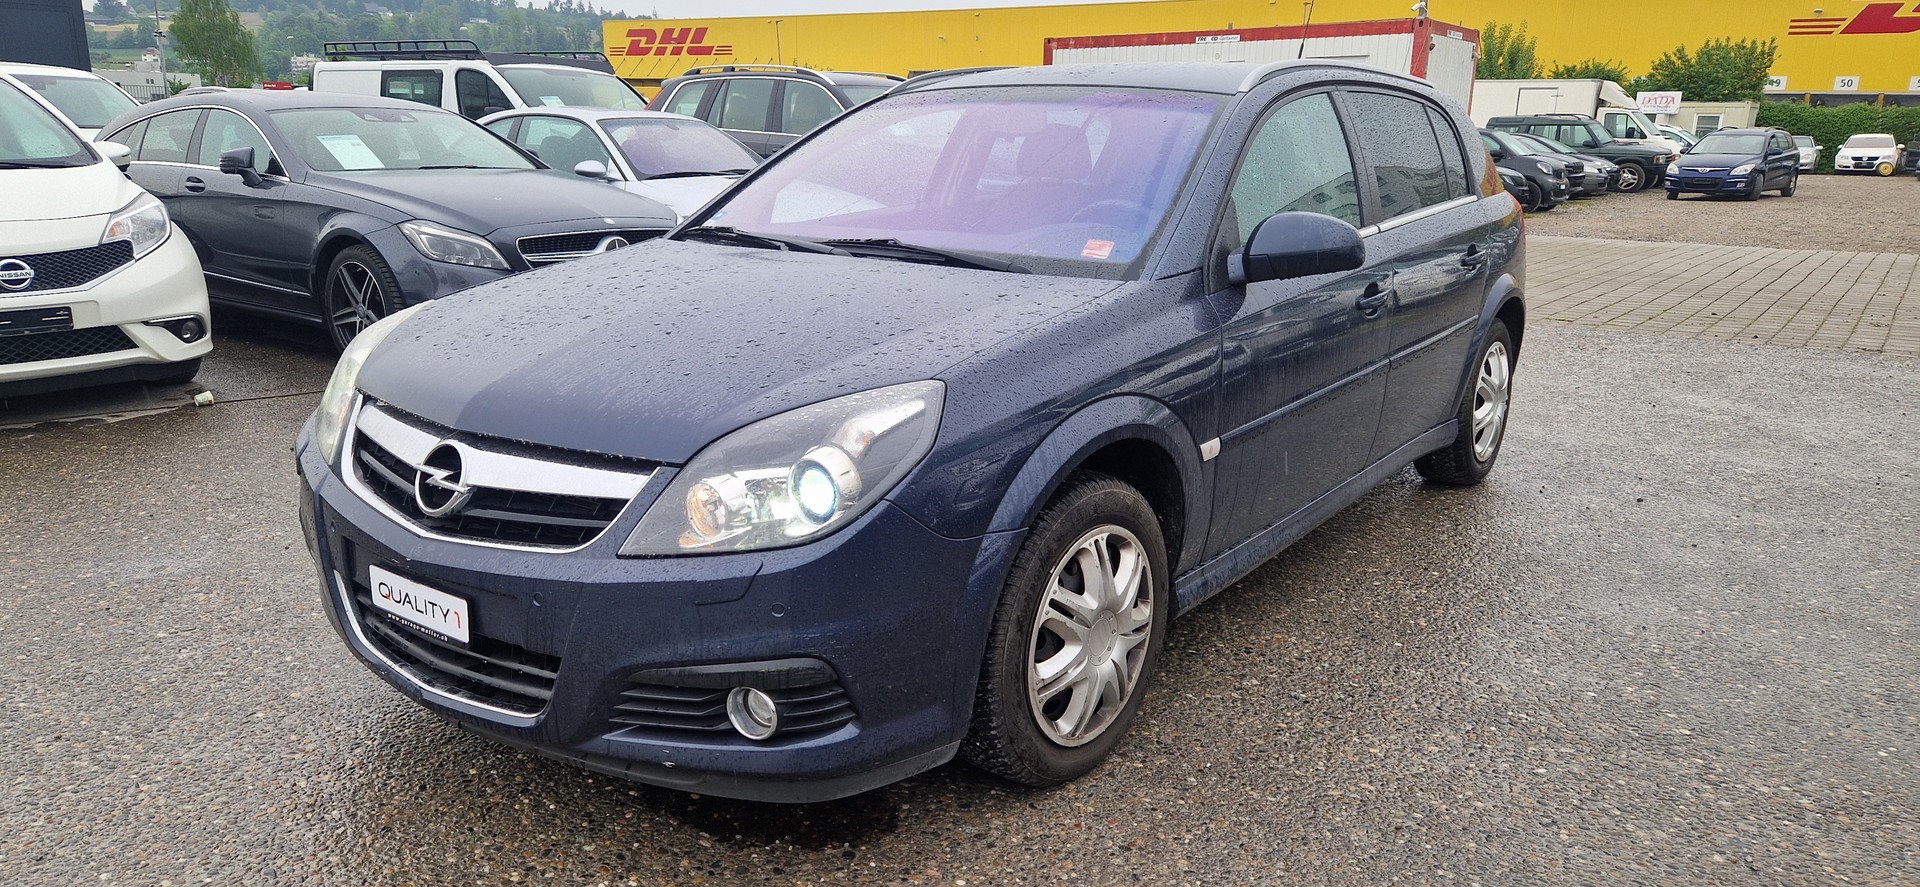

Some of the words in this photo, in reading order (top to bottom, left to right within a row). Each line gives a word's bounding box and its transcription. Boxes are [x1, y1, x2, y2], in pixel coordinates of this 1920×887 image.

[625, 27, 714, 56] DHL
[1840, 79, 1853, 87] 50
[1642, 96, 1675, 105] DADA
[378, 582, 450, 623] QUALITY
